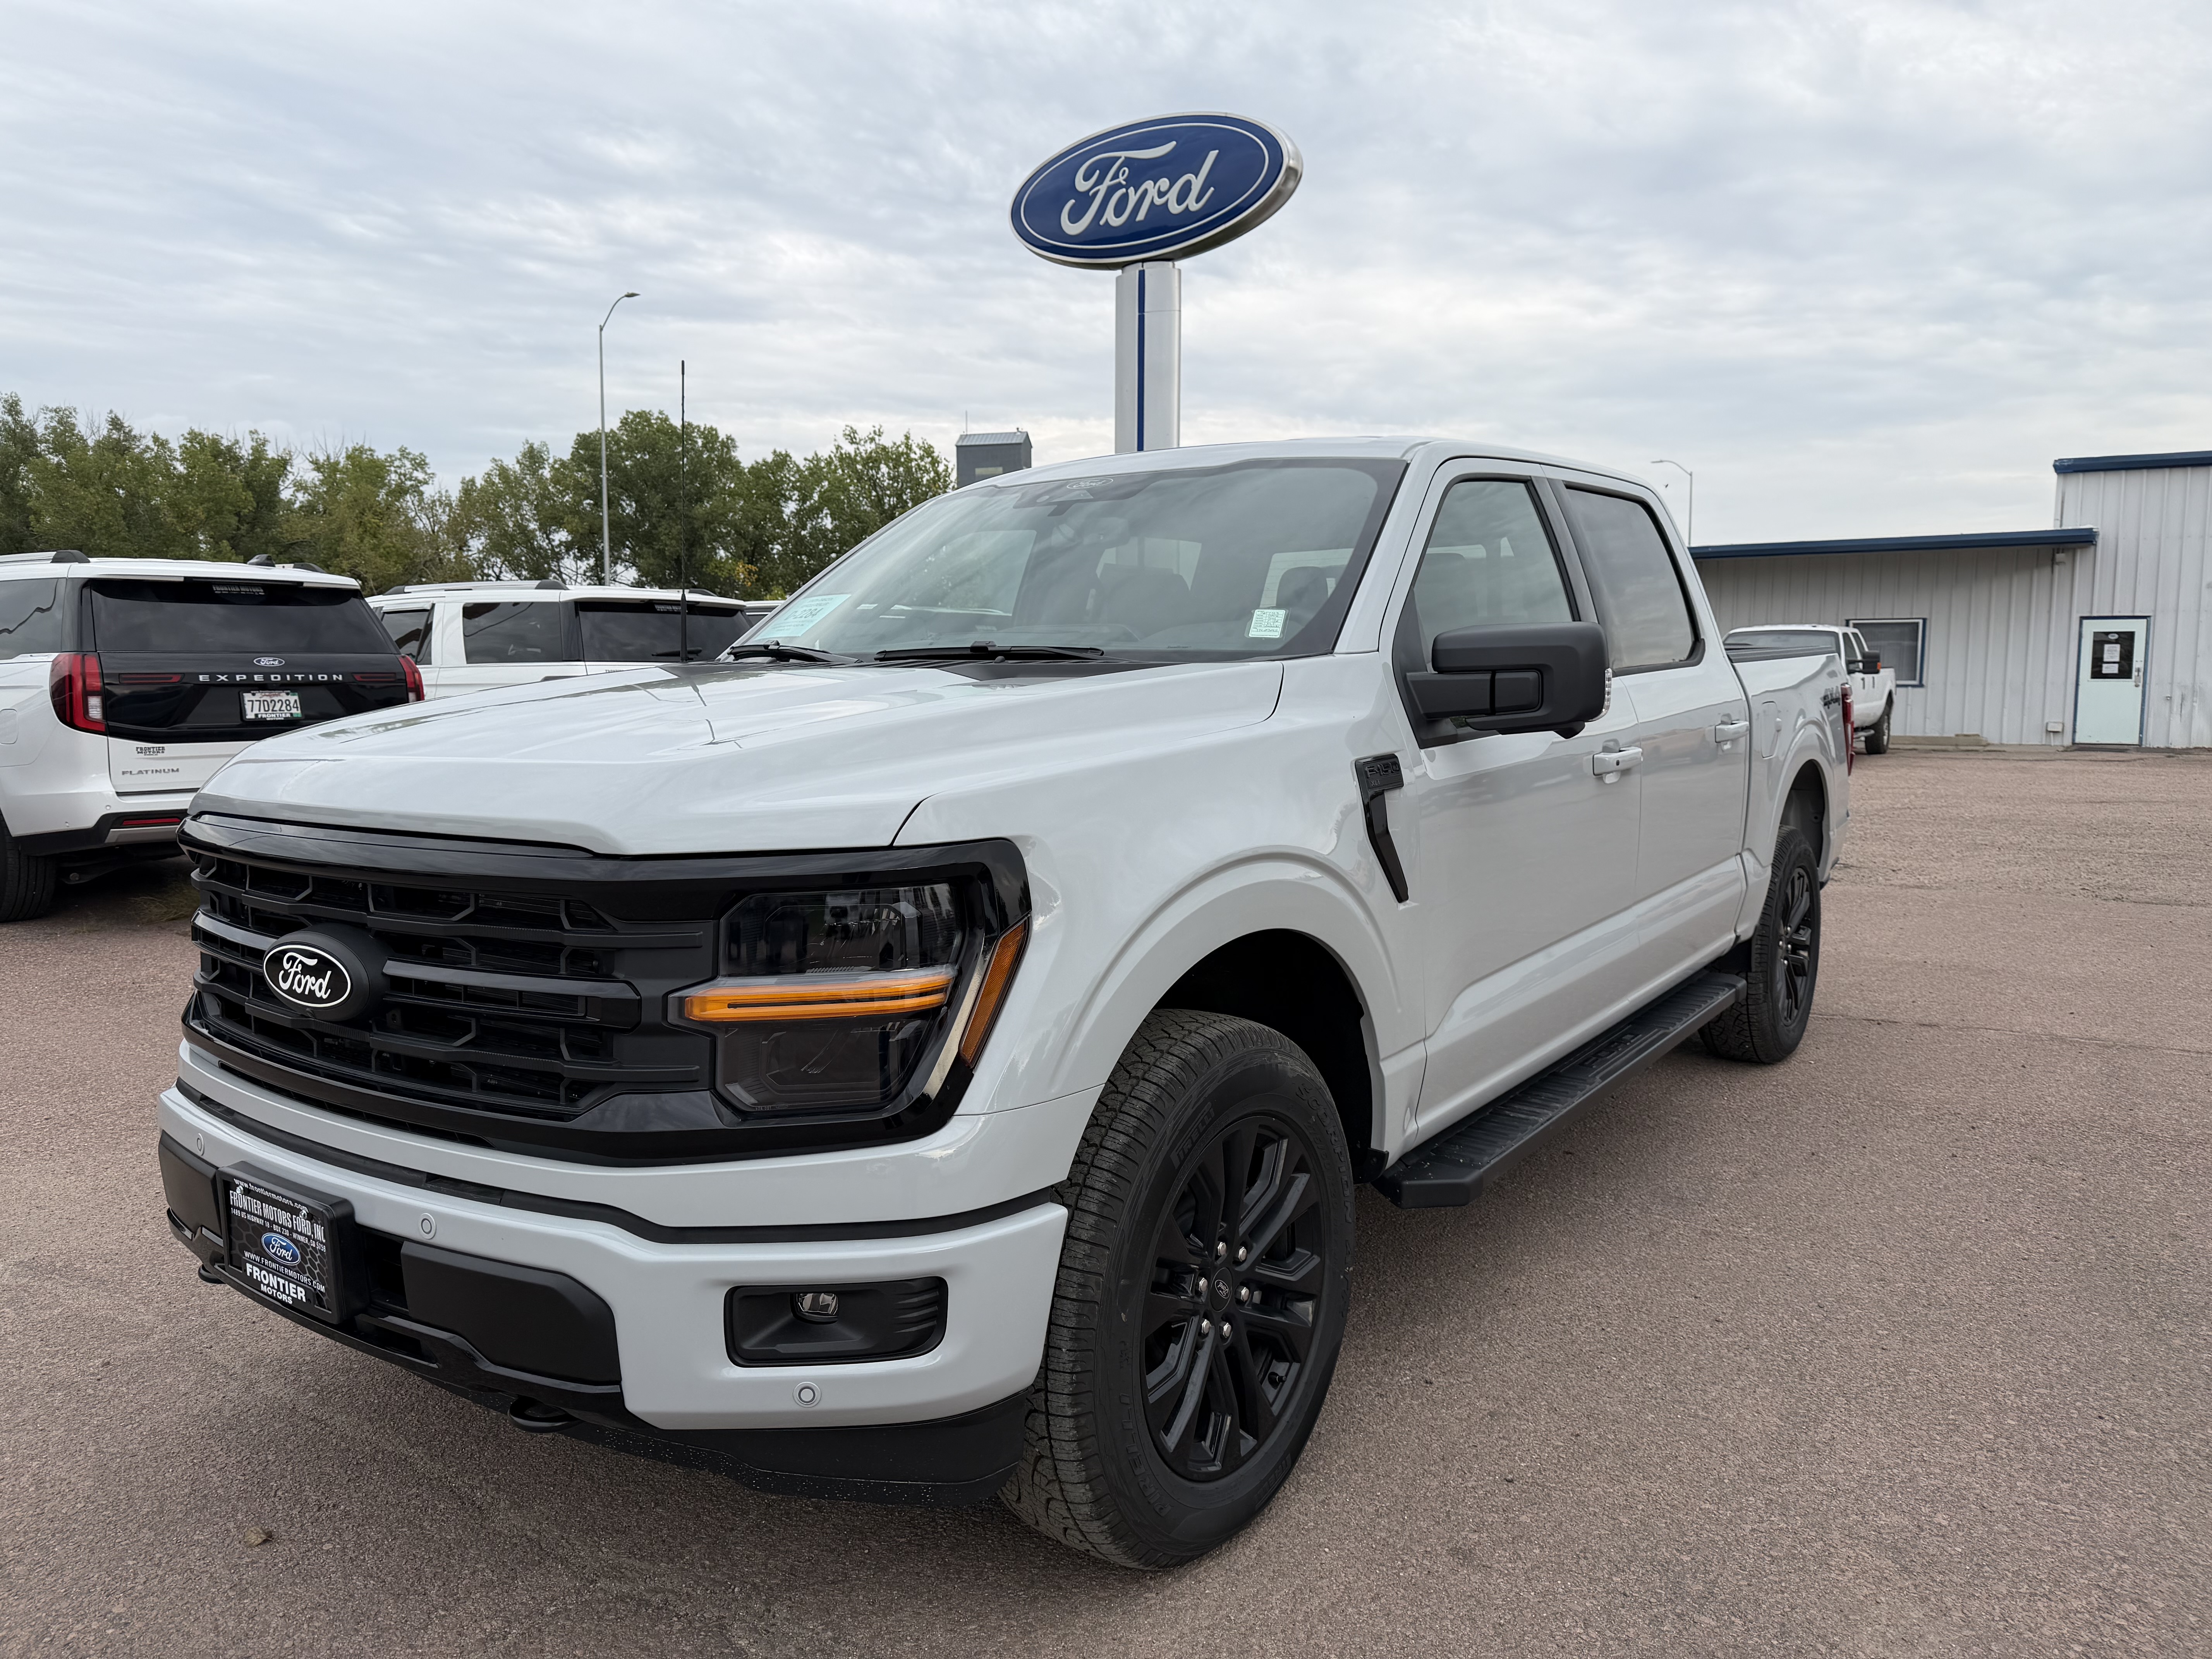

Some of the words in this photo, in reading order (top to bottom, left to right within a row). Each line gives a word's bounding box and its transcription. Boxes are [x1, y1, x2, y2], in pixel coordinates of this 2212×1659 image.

[1060, 141, 1219, 236] Ford
[1073, 479, 1106, 488] Ford
[247, 699, 299, 713] 77D2284
[1365, 761, 1400, 779] F-150
[279, 952, 331, 999] Ford
[1170, 1102, 1215, 1170] PIRELLI
[1295, 1083, 1352, 1224] SCORPION
[230, 1190, 262, 1216] FRONTIER
[263, 1203, 292, 1228] MOTORS
[234, 1178, 309, 1213] www.frontiermotors.com
[247, 1213, 264, 1226] HIGHWAY
[273, 1224, 281, 1233] BOX
[292, 1232, 310, 1245] WINNER,
[270, 1237, 293, 1261] Ford
[244, 1250, 325, 1293] WWW.FRONTIERMOTORS.COM
[246, 1263, 306, 1302] FRONTIER
[1217, 1281, 1228, 1297] Ford
[261, 1284, 292, 1304] MOTORS
[1119, 1392, 1174, 1518] PIRELLI
